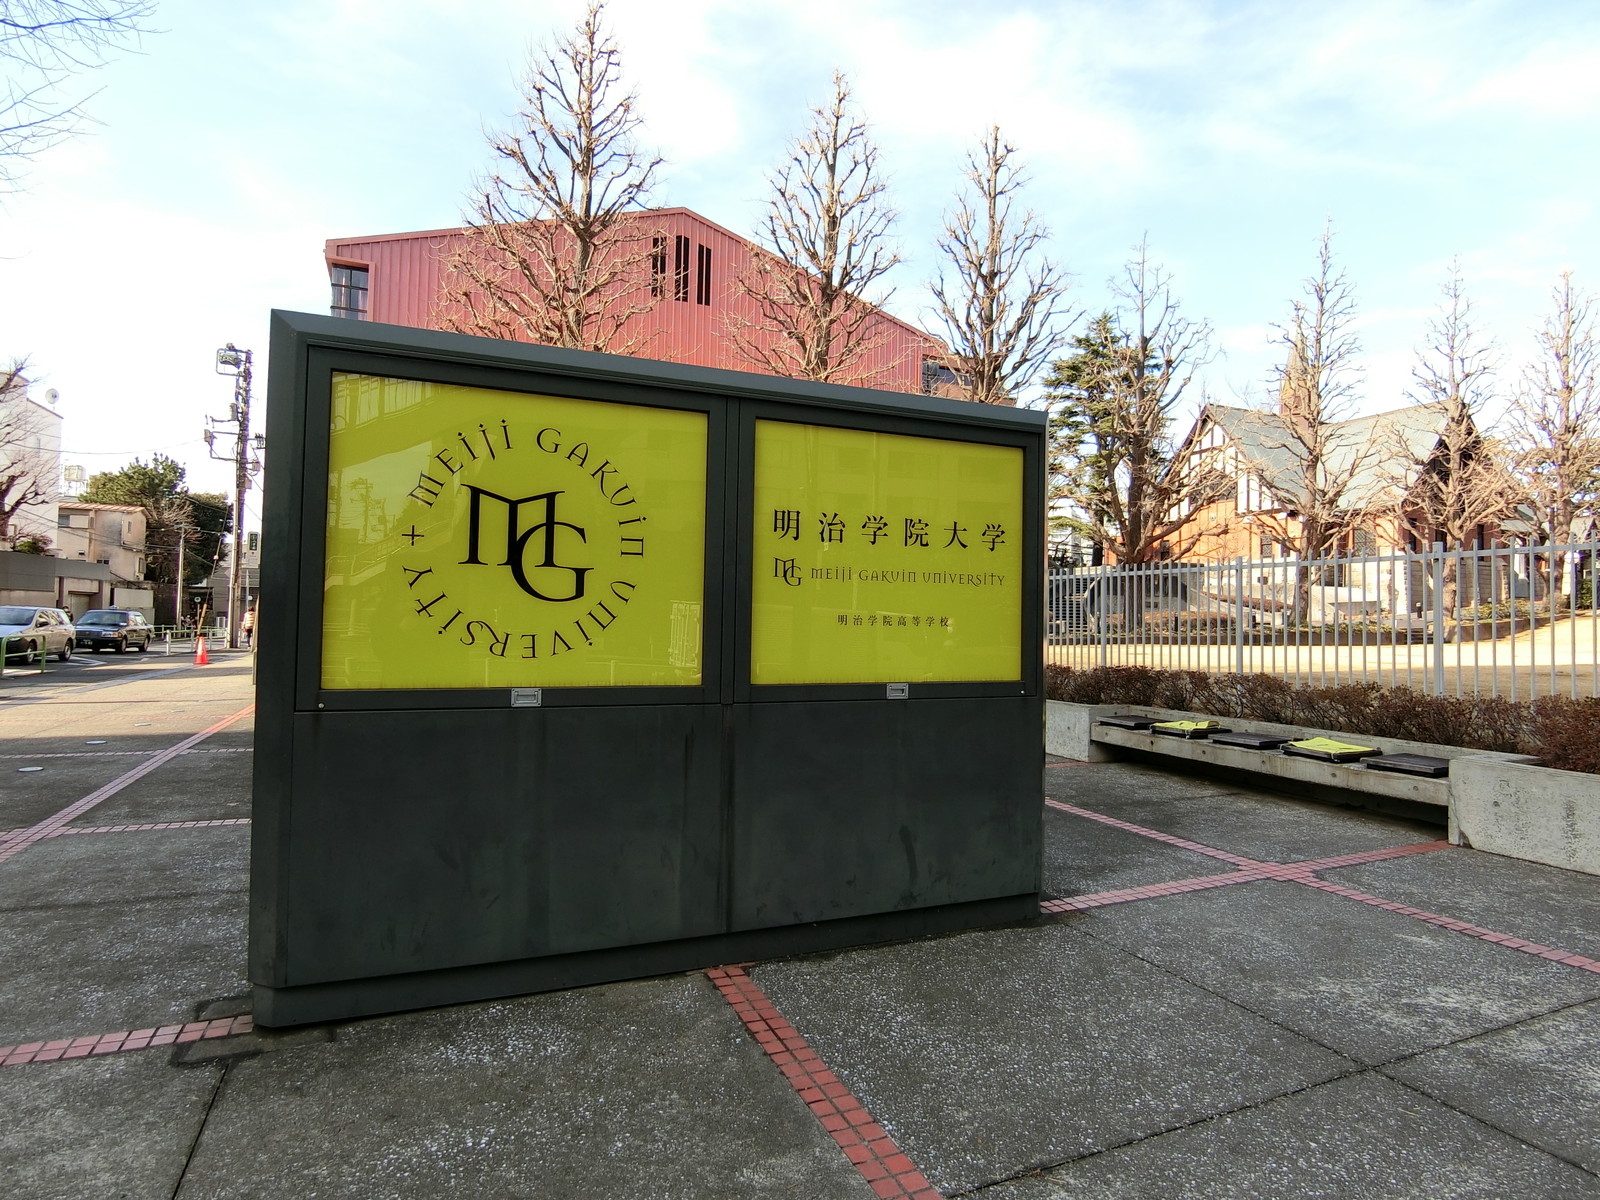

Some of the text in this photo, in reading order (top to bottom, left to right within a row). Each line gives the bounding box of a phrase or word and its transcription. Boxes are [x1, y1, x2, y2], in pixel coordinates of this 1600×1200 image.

[457, 483, 595, 603] MG
[773, 508, 1006, 553] 明治学院大学
[837, 613, 950, 628] 明治学院高等学校
